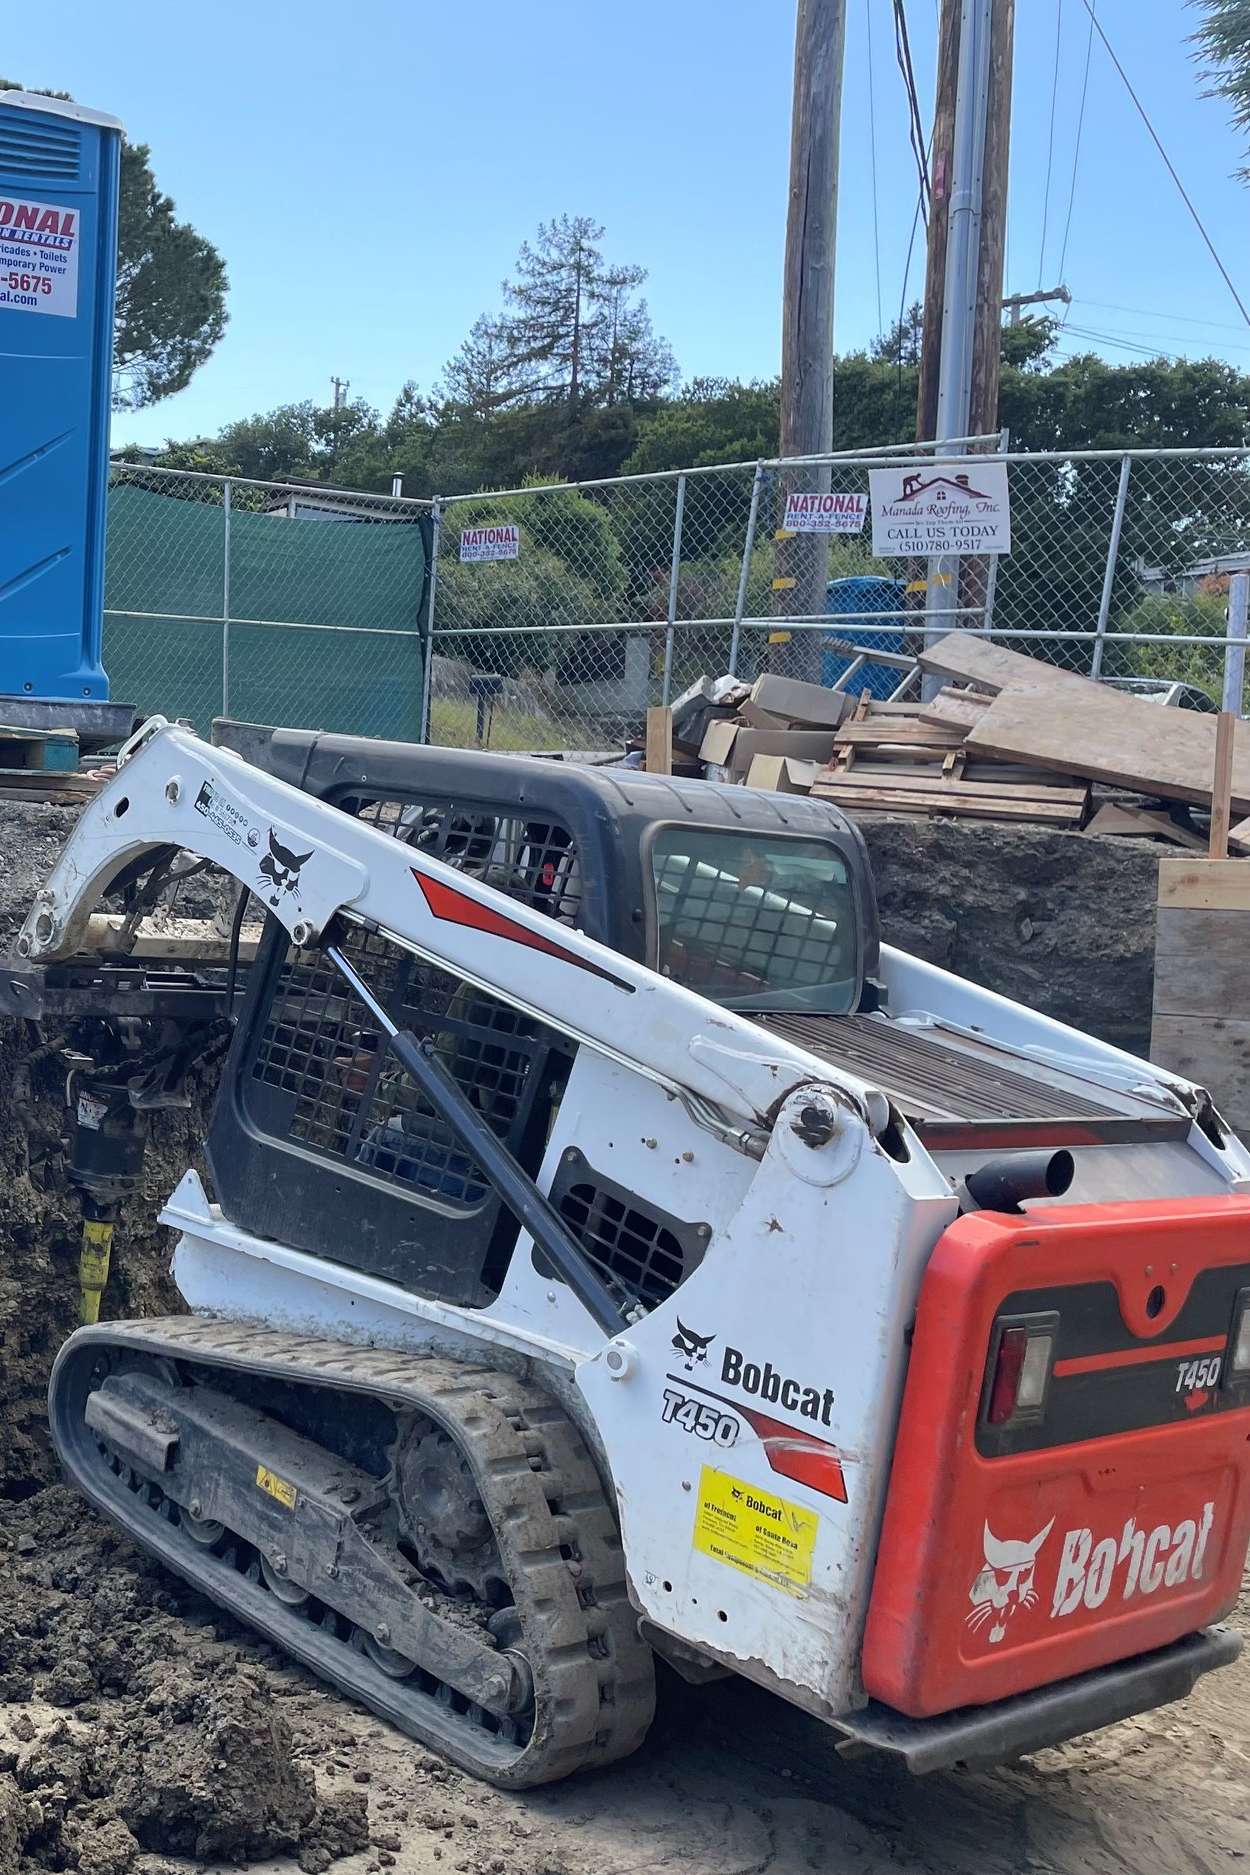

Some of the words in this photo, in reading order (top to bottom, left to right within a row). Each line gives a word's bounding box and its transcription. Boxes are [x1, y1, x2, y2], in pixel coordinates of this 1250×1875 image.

[14, 229, 70, 248] RENTALS
[39, 249, 68, 263] Toilets
[39, 262, 67, 275] Power
[788, 495, 864, 513] NATIONAL
[881, 501, 924, 517] Manada
[926, 501, 972, 520] Roofing,
[786, 512, 863, 520] RENT-A-FENCE
[462, 527, 518, 546] NATIONAL
[887, 528, 923, 540] CALL
[926, 527, 946, 539] US
[949, 525, 999, 538] TODAY
[899, 539, 982, 552] (510)780-9517
[1176, 1357, 1222, 1392] T450
[721, 1346, 835, 1426] Bobcat
[662, 1388, 740, 1448] T450
[746, 1495, 783, 1522] Bobcat
